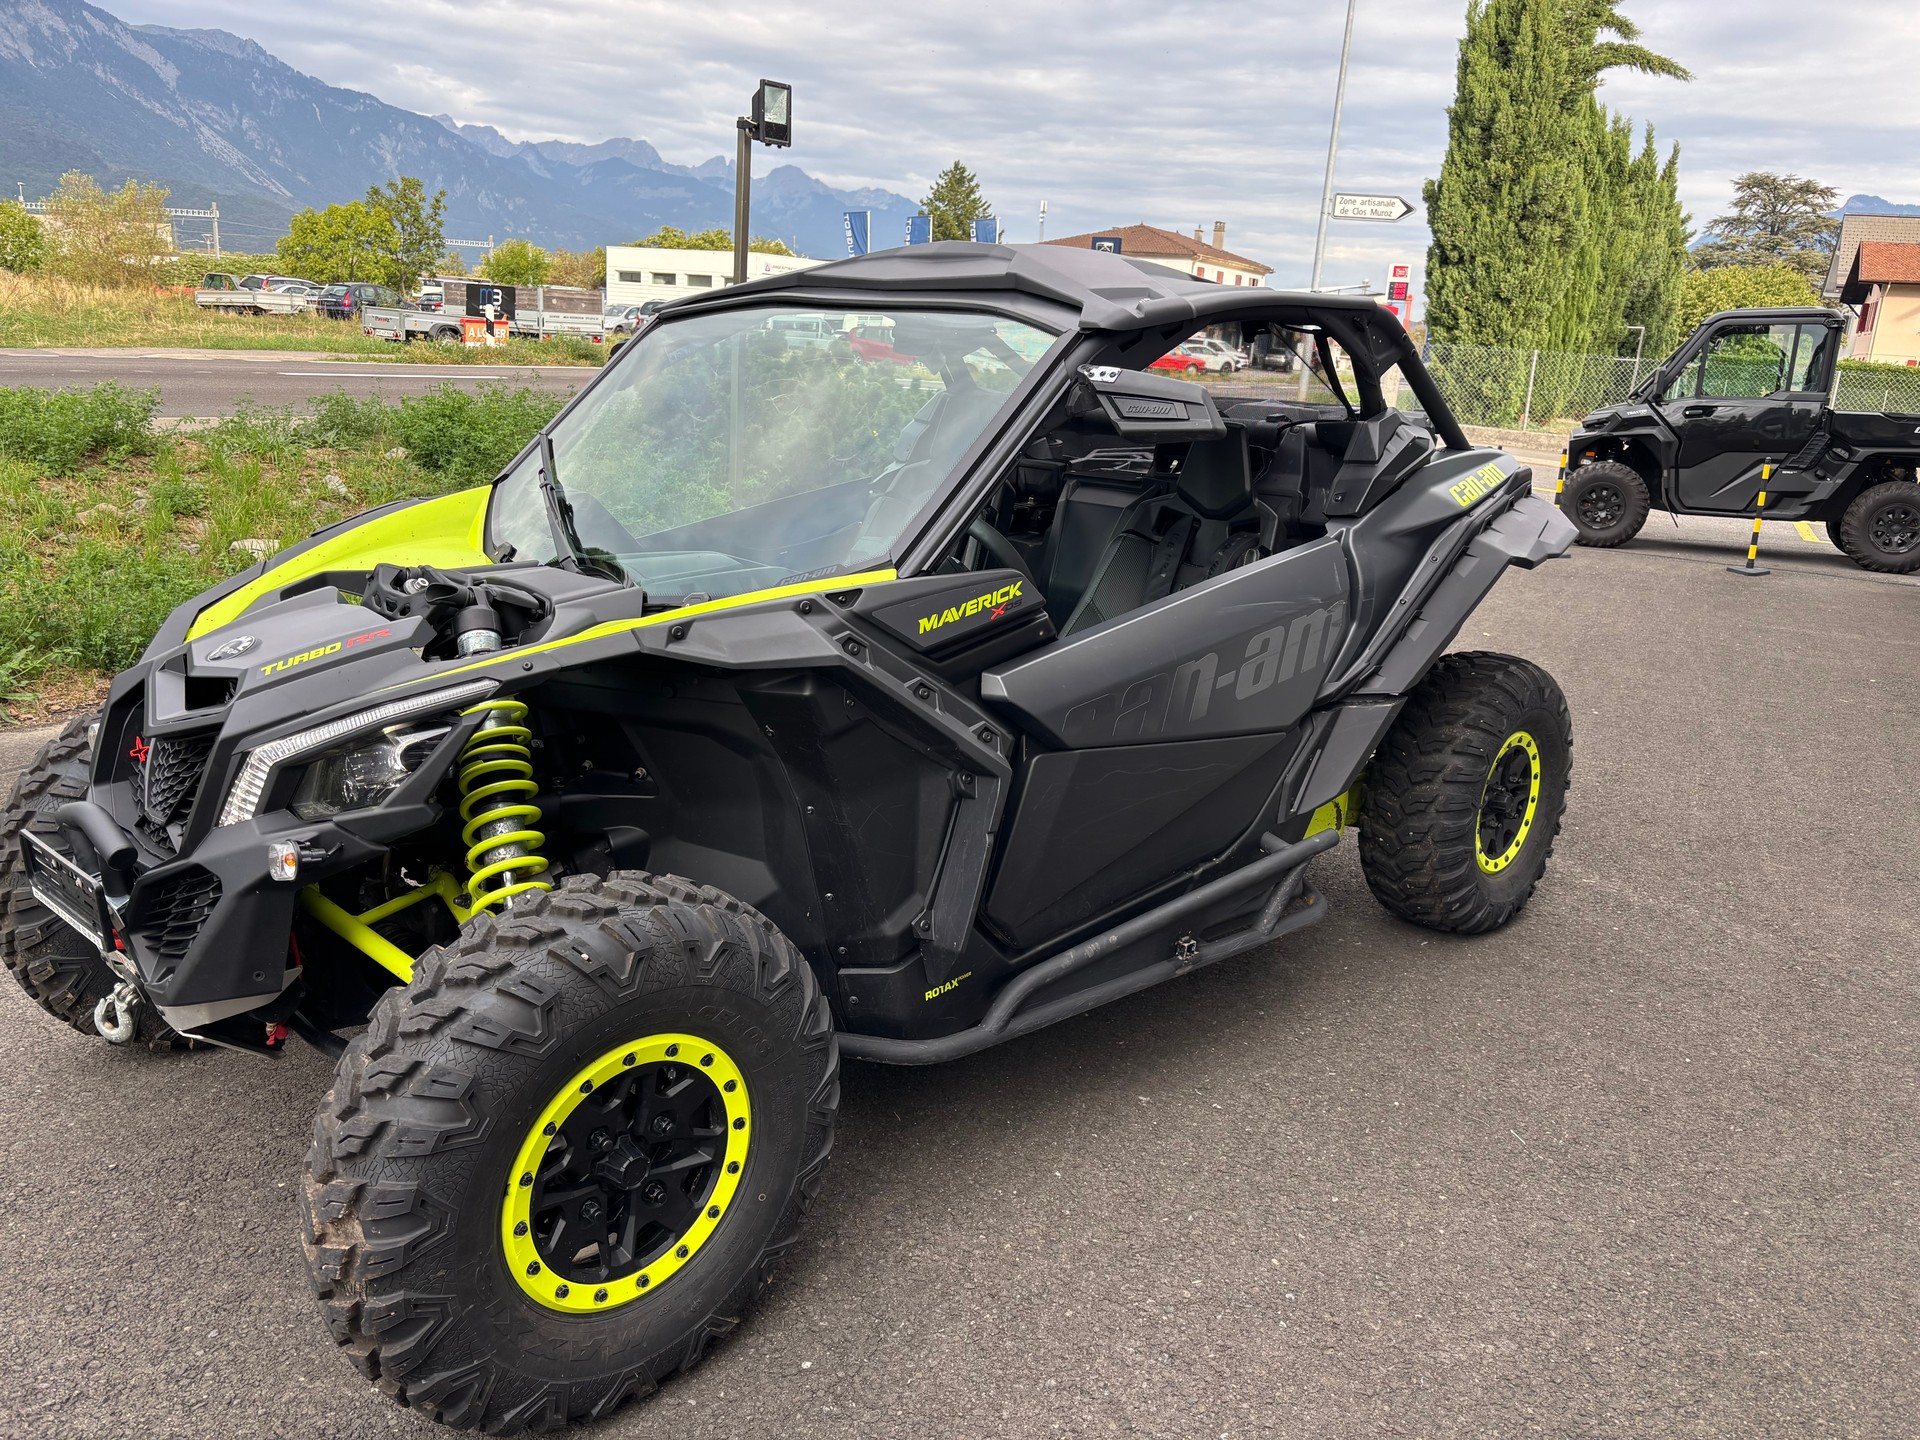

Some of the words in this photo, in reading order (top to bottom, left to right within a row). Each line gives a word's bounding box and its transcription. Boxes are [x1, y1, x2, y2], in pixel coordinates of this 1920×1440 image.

[1339, 197, 1357, 206] Zone
[1360, 199, 1396, 208] artisanale
[1340, 206, 1349, 215] de
[1352, 207, 1367, 216] Clos
[1370, 208, 1393, 217] Muroz
[468, 327, 476, 337] A
[1126, 404, 1172, 415] can-am
[1449, 463, 1506, 507] can-am
[780, 565, 838, 586] can-am
[918, 580, 1023, 635] MAVERICK
[260, 641, 342, 676] TURBO
[346, 629, 392, 648] RR
[925, 977, 959, 1002] ROTAX
